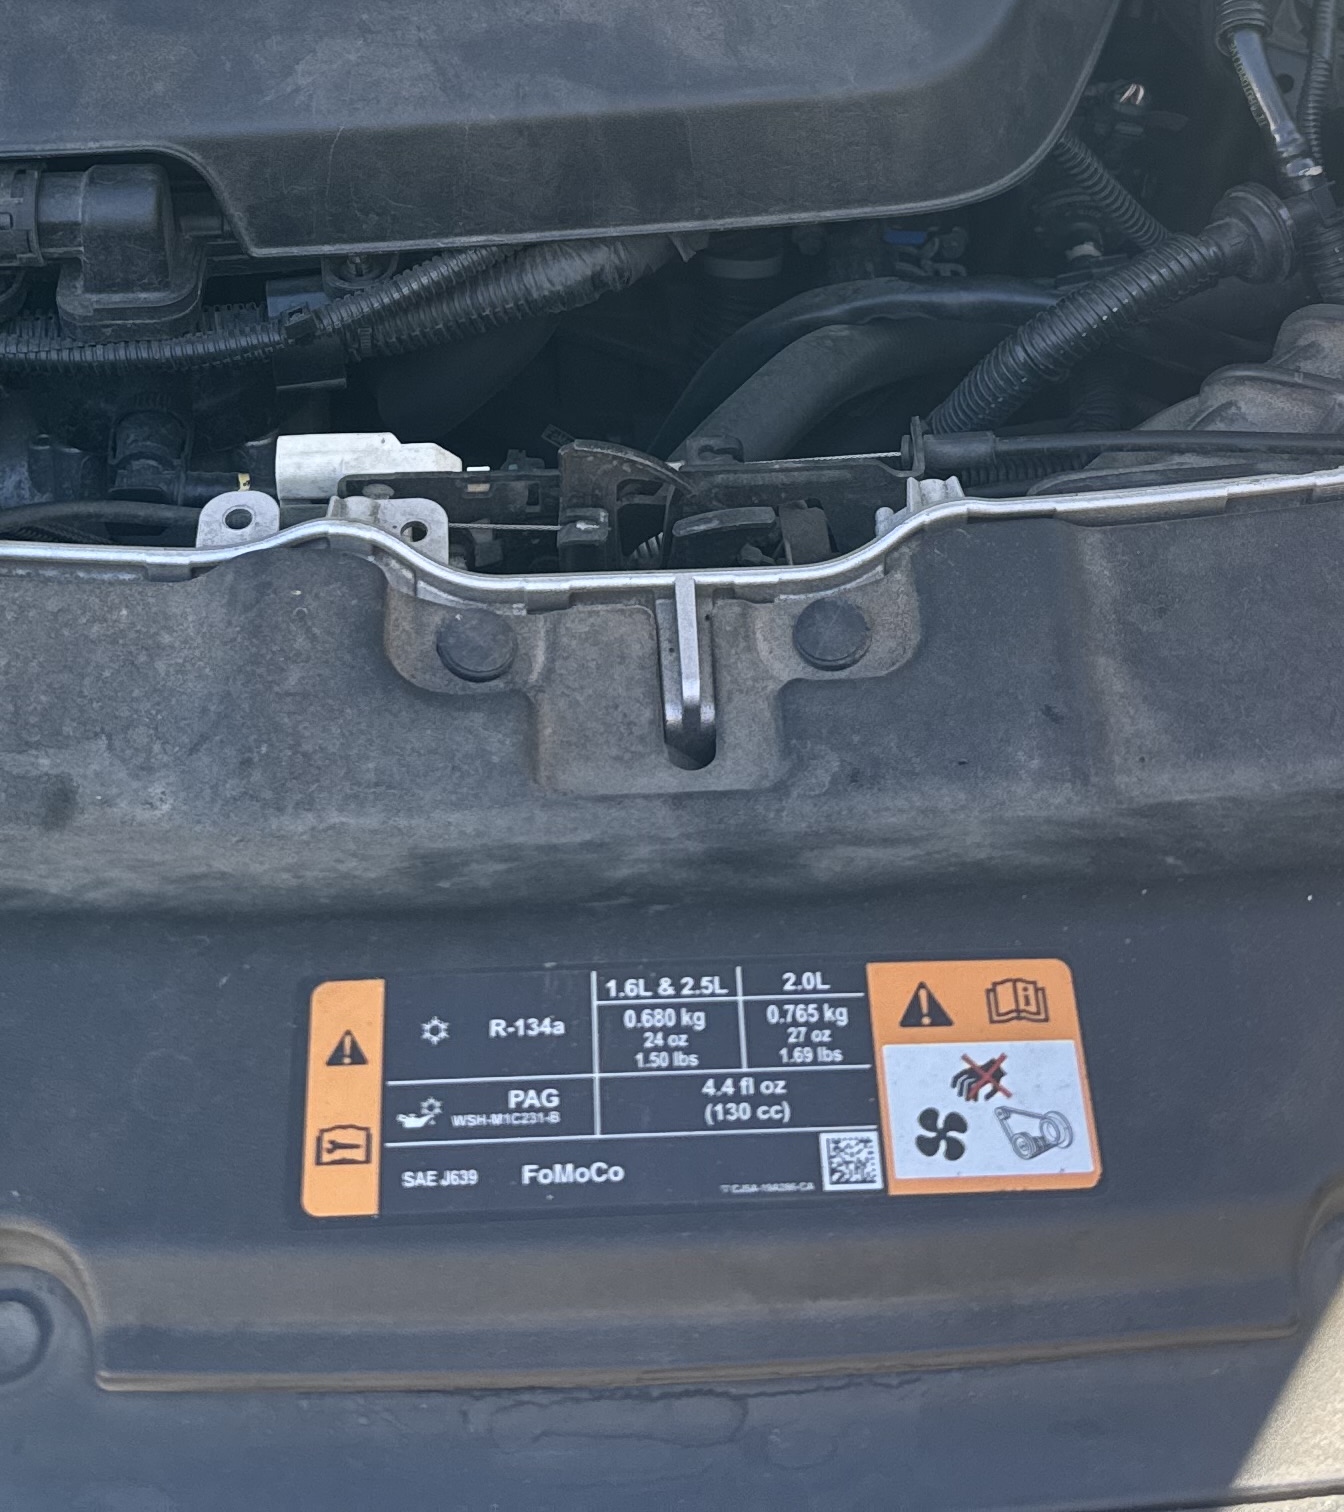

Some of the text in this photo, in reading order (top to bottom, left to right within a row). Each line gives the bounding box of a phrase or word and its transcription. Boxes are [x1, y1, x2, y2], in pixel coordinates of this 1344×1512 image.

[605, 976, 729, 998] 1.6L & 2.5L
[781, 971, 831, 991] 2.0L
[622, 1007, 706, 1032] 0.680 kg
[766, 1003, 849, 1027] 0.765 kg
[488, 1016, 566, 1038] R-134a
[786, 1026, 832, 1044] 27 oz
[642, 1031, 689, 1049] 24 oz
[634, 1050, 700, 1069] 1.50 lbs
[778, 1045, 844, 1064] 1.69 lbs
[701, 1076, 788, 1096] 4.4 fl oz
[507, 1088, 560, 1109] PAG
[704, 1100, 792, 1126] (130 cc)
[401, 1168, 479, 1188] SAE J639
[520, 1161, 626, 1185] FoMoCo
